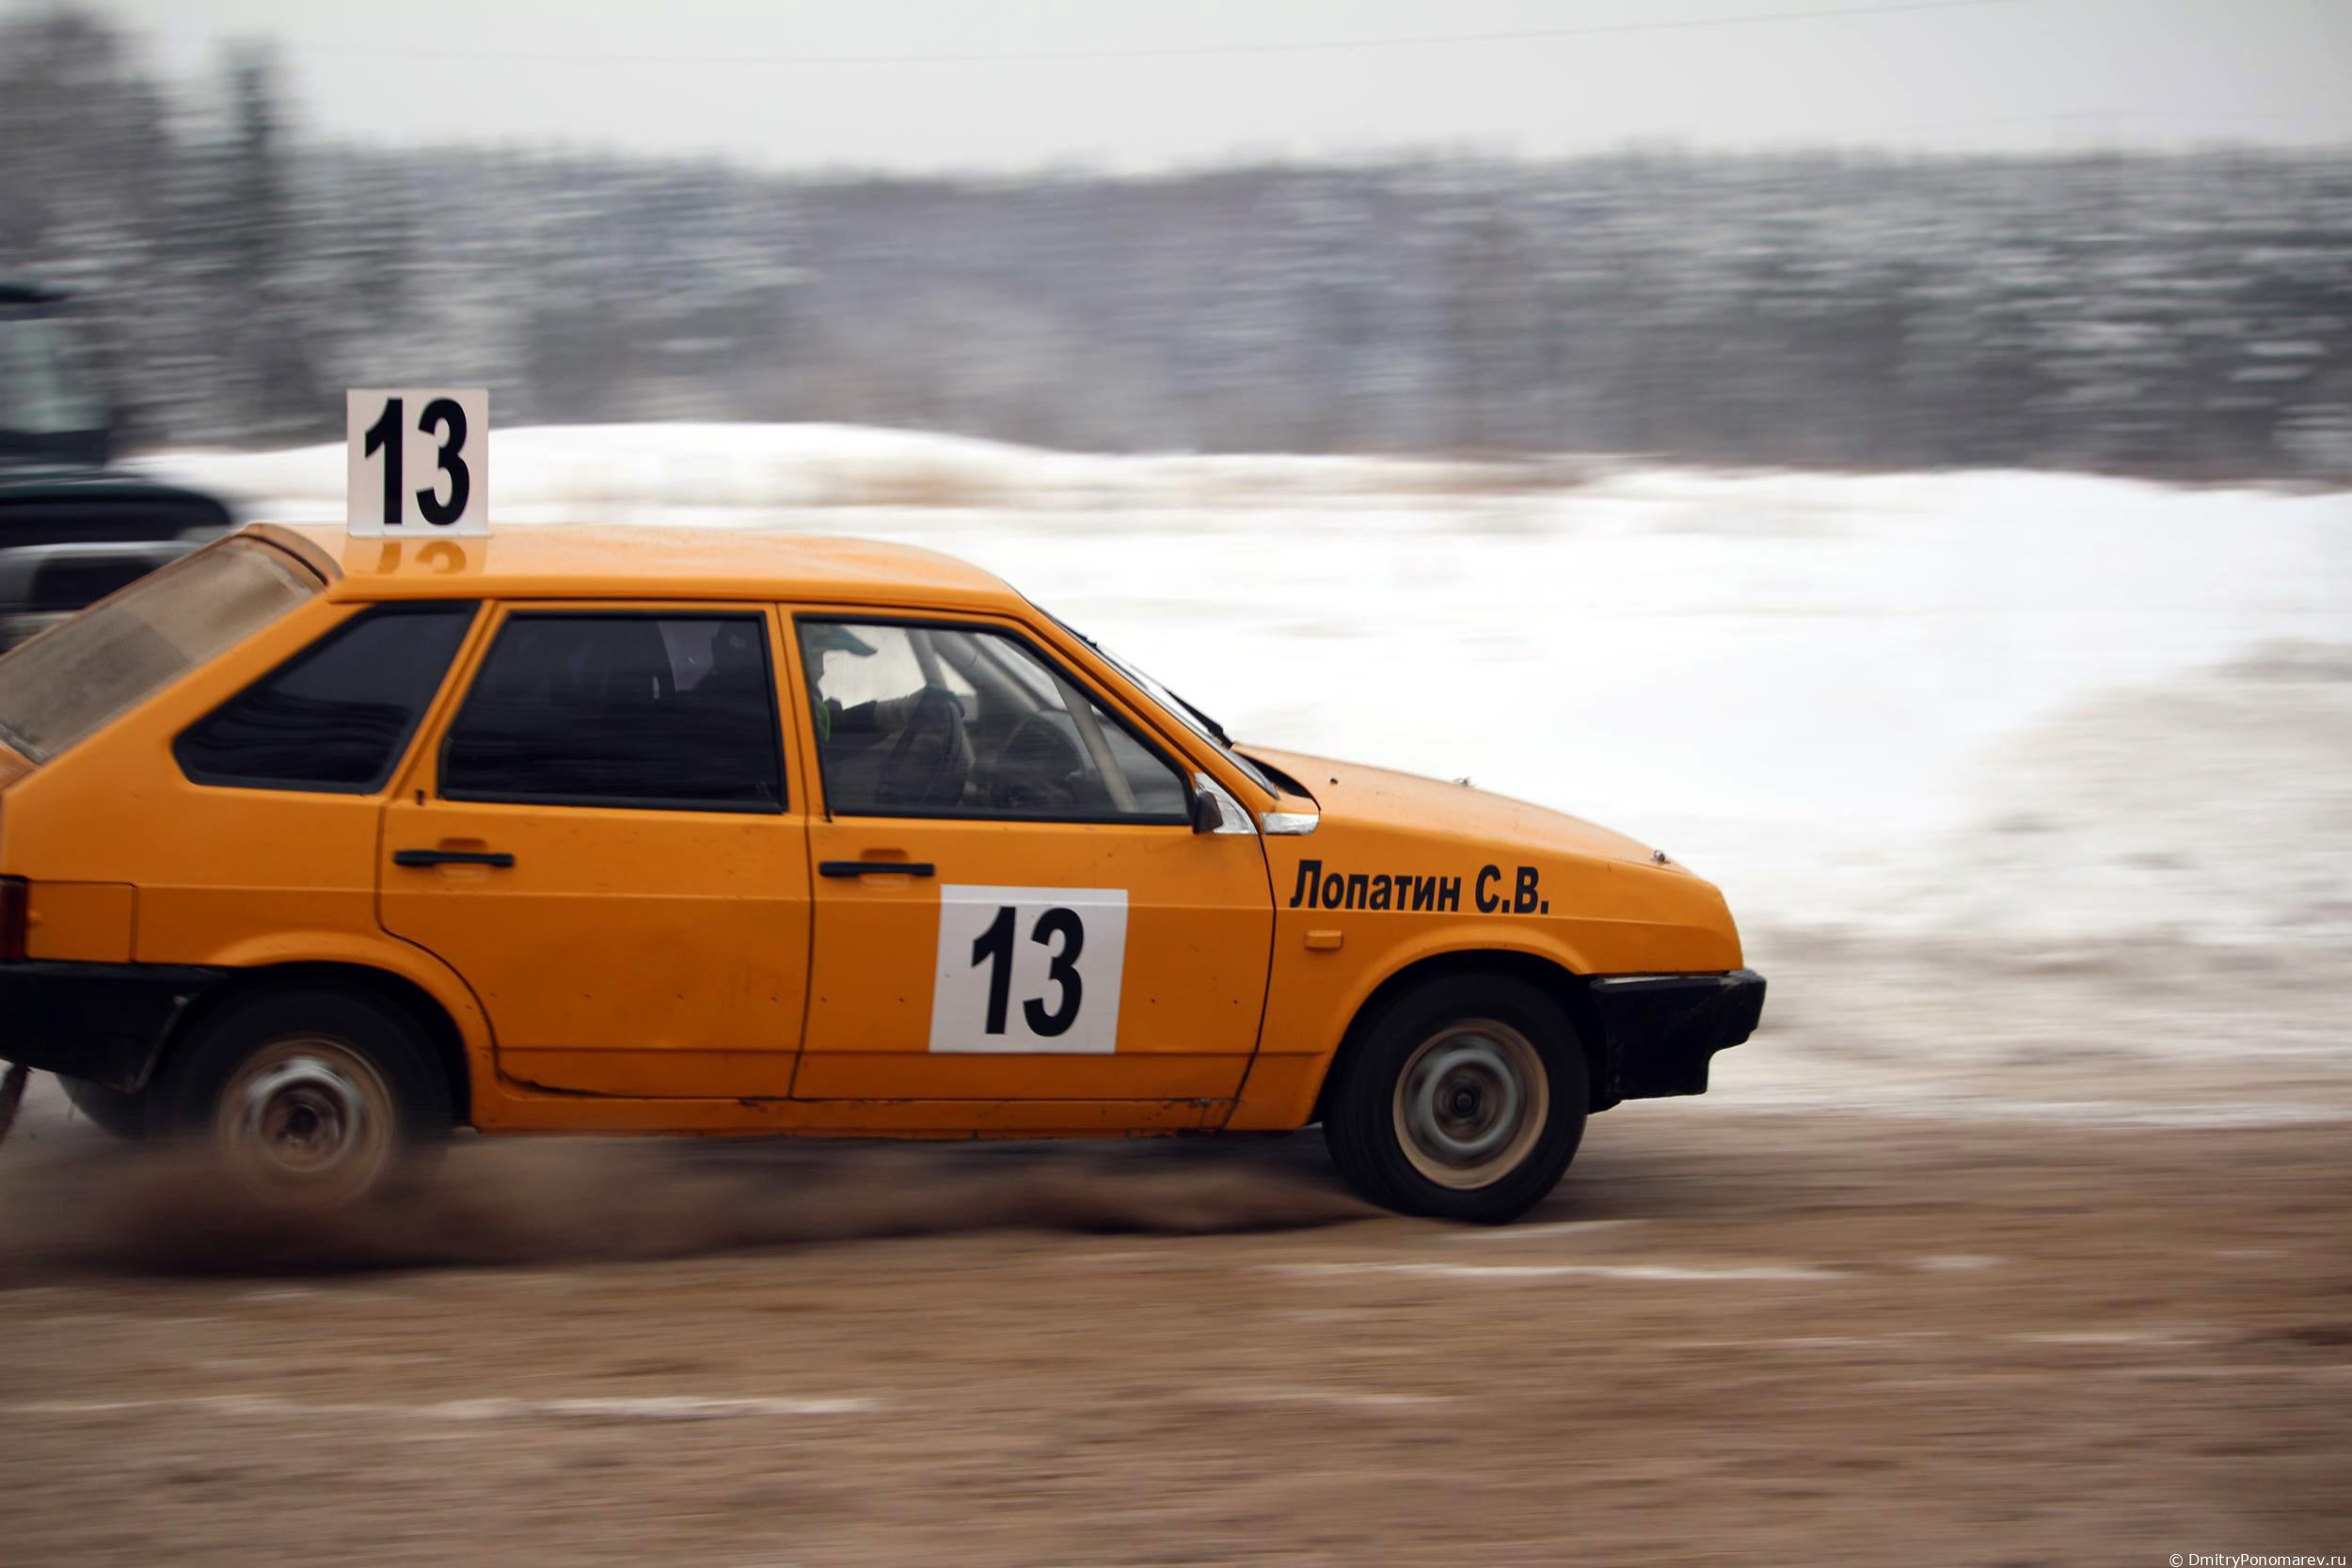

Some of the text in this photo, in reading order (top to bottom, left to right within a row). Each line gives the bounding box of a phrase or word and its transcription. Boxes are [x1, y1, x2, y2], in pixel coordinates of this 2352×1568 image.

[364, 397, 470, 526] 13
[1289, 859, 1549, 914] Лопатин С.В.
[971, 906, 1084, 1037] 13
